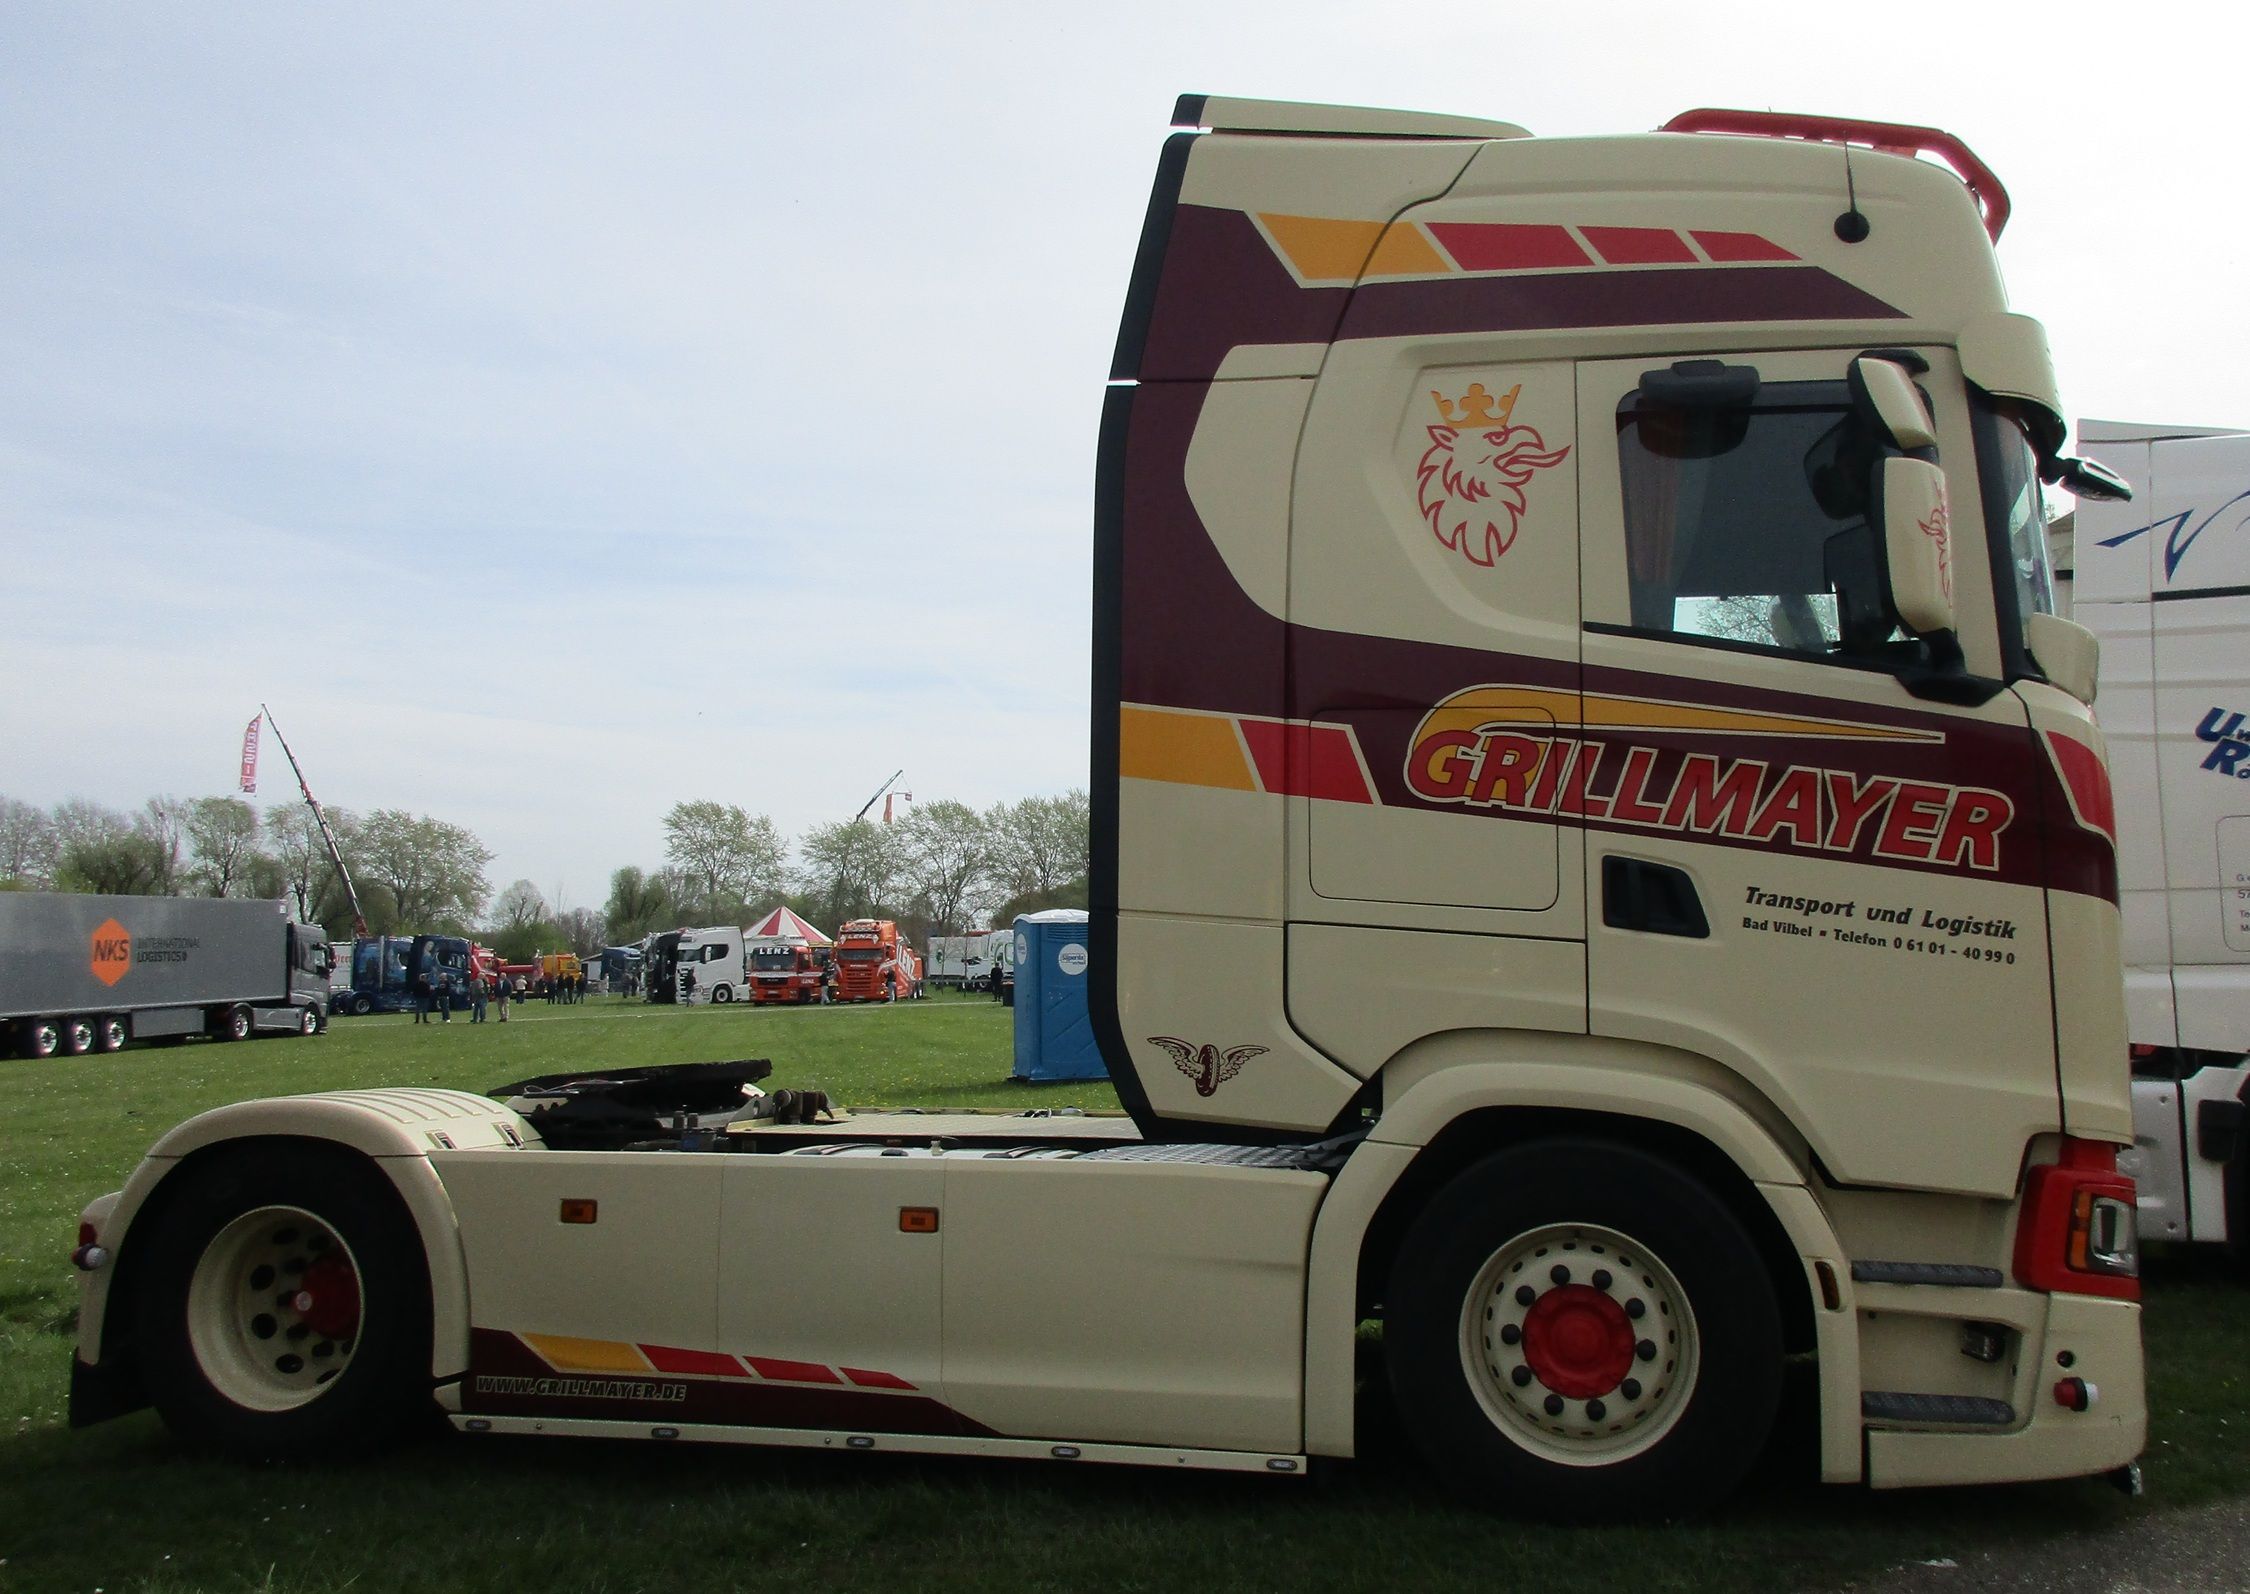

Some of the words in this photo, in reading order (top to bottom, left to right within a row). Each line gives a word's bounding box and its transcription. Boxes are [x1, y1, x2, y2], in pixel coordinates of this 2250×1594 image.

[1404, 729, 2014, 871] GRILLMAYER
[1745, 886, 1855, 918] Transport
[1866, 907, 1913, 925] und
[1920, 910, 2017, 940] Logistik
[94, 939, 129, 961] NKS
[759, 947, 790, 955] LENZ
[1742, 917, 1769, 932] Bad
[1773, 920, 1813, 938] Vilbel
[1834, 929, 1888, 948] Telefon
[1893, 937, 1903, 950] 0
[1906, 939, 1924, 953] 61
[1928, 942, 1946, 956] 01
[1962, 946, 1981, 960] 40
[1984, 949, 2002, 964] 99
[2006, 952, 2016, 966] 0
[476, 1375, 687, 1402] WWW.GRILLMAYER.DE
